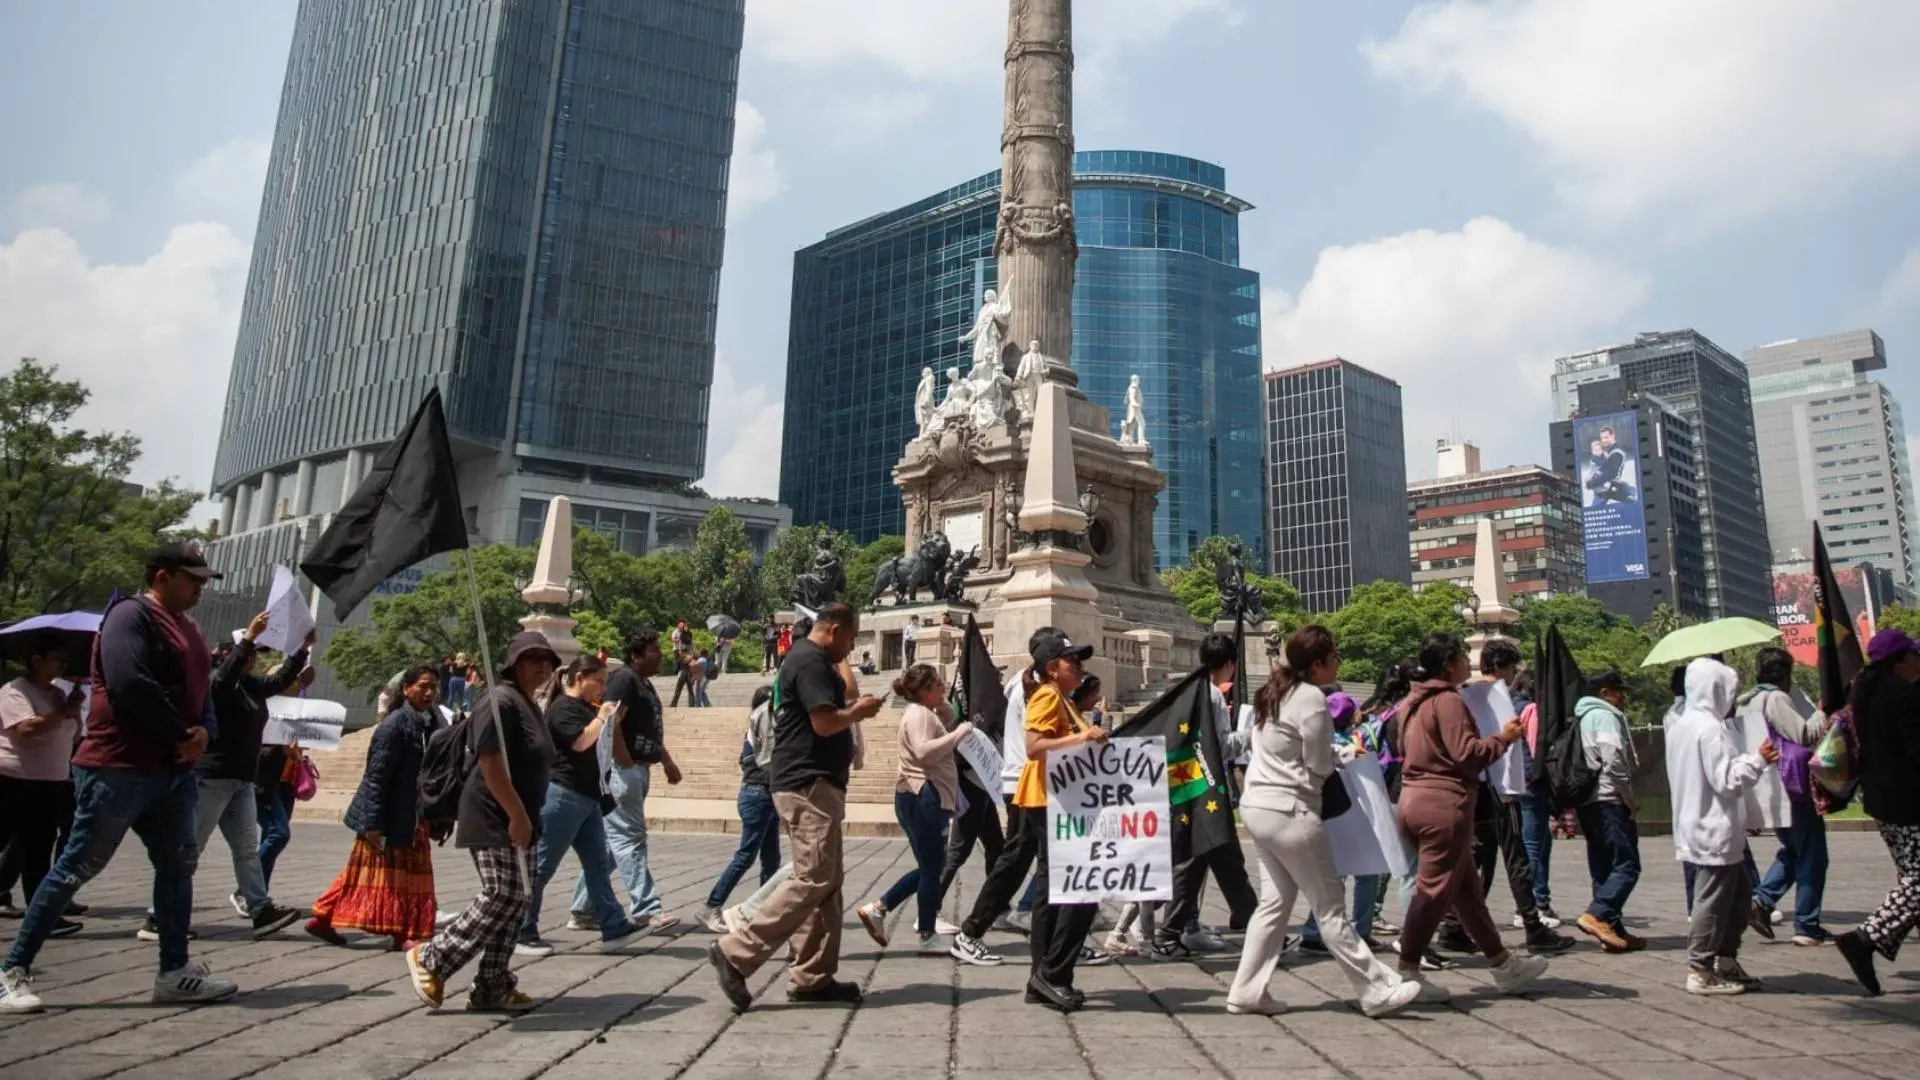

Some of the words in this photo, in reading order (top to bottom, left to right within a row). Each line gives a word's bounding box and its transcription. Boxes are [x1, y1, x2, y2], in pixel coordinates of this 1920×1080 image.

[1625, 563, 1645, 573] VISA
[1081, 783, 1135, 808] SER
[1056, 810, 1158, 840] HUMANO
[1089, 841, 1118, 861] ES
